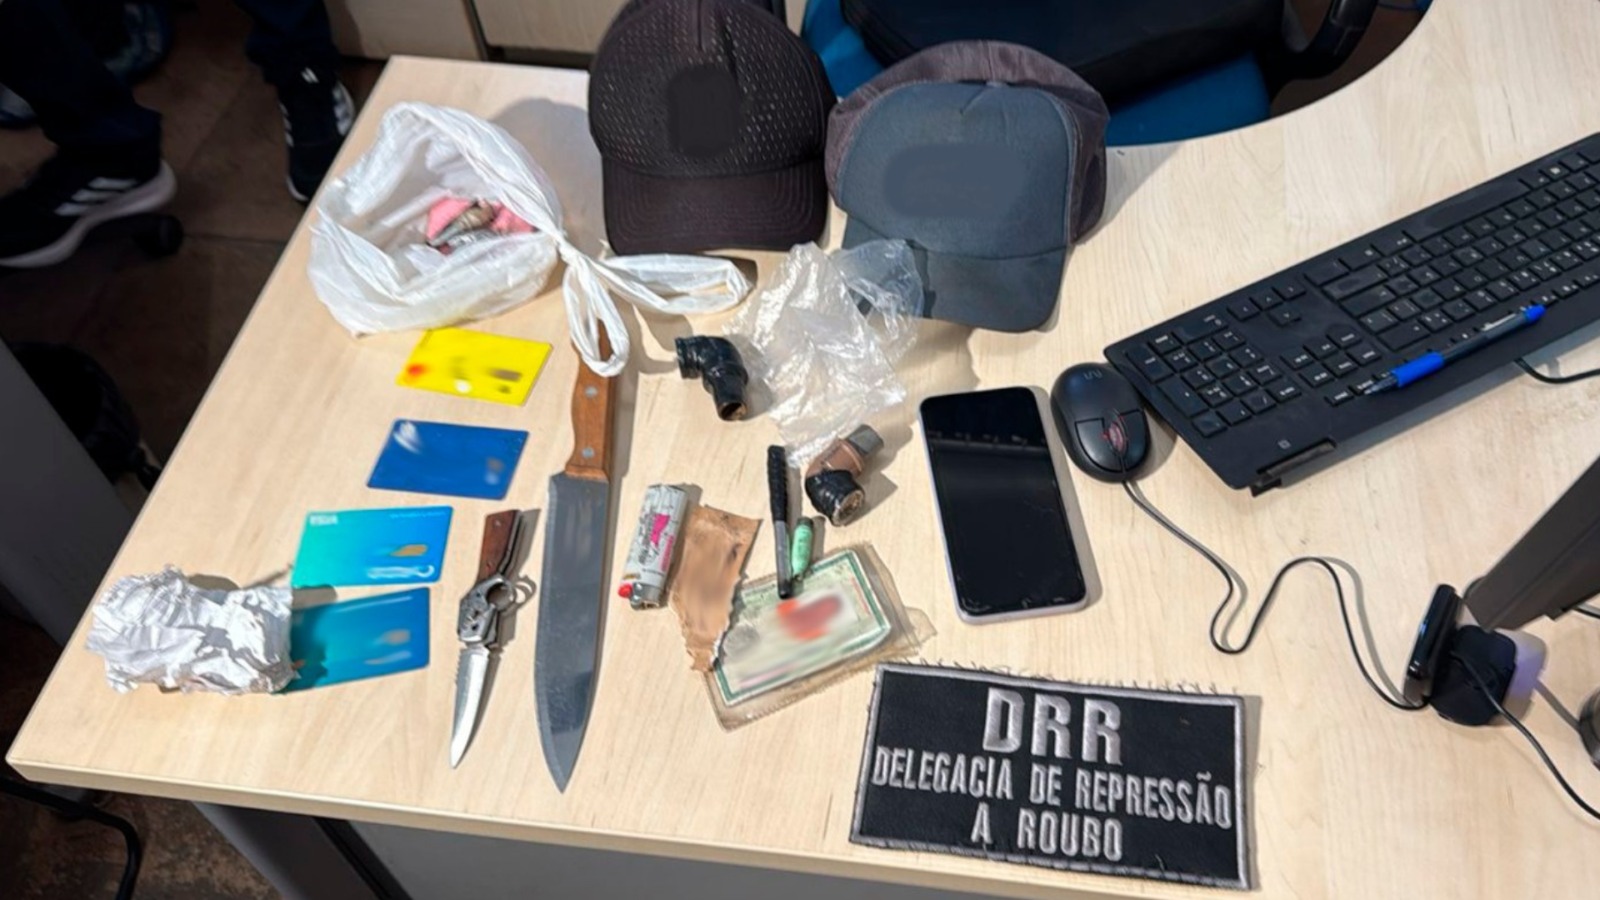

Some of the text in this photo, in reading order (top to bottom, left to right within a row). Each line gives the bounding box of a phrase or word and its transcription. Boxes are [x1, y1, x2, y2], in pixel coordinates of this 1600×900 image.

[982, 687, 1122, 766] DRR
[871, 745, 1233, 830] DELEGACIA DE REPRESSÃO
[1017, 807, 1123, 862] ROUBO
